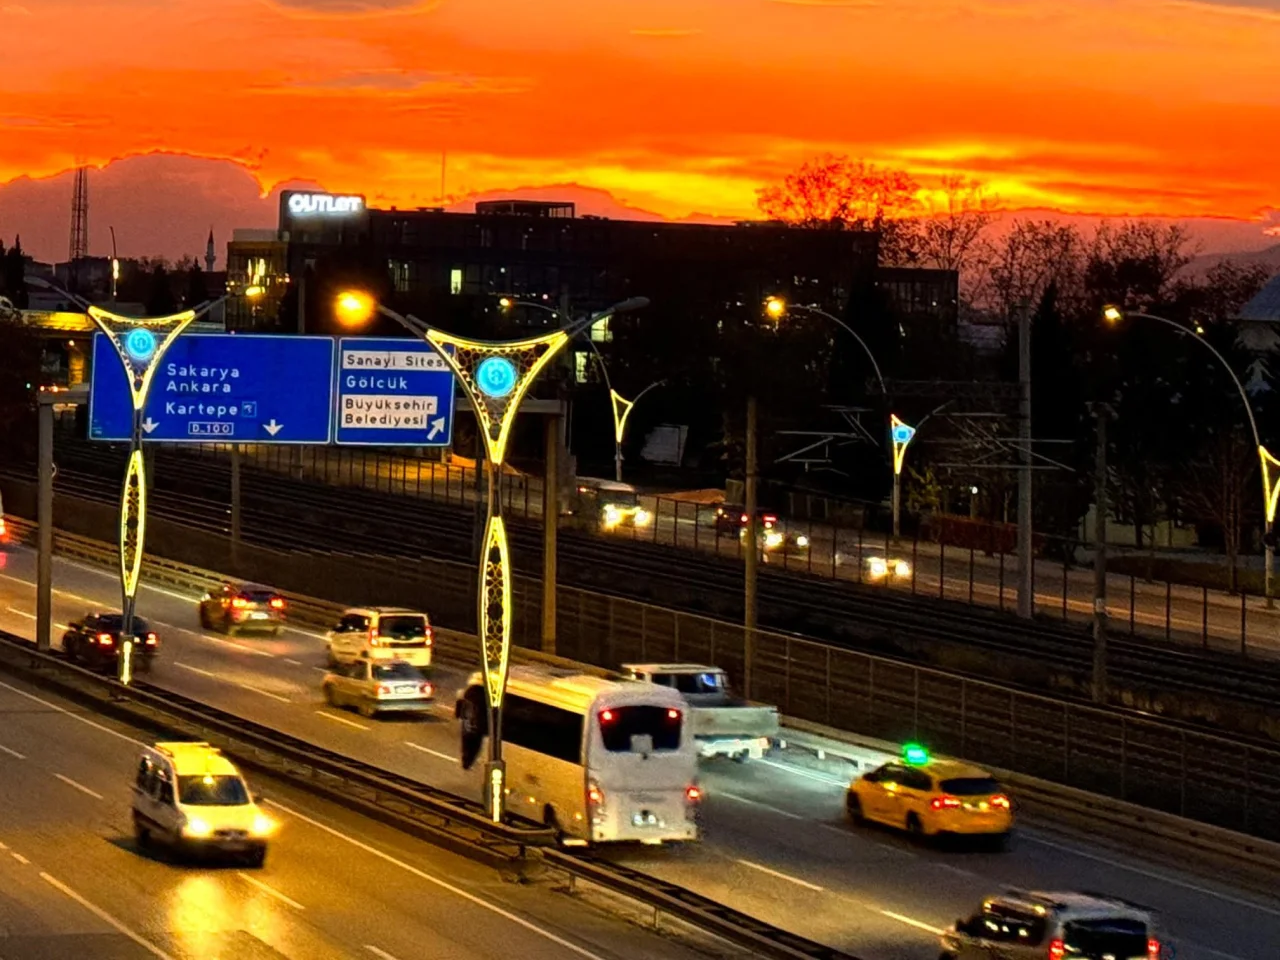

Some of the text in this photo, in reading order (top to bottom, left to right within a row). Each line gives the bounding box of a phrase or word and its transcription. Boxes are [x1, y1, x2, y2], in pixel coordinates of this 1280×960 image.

[288, 193, 363, 213] OUTLET
[347, 354, 396, 368] Sanayi
[167, 363, 240, 381] Sakarya
[166, 380, 232, 393] Ankara
[346, 374, 408, 390] Gölcük
[166, 401, 238, 418] Kartepe
[345, 413, 424, 427] Belediyesi
